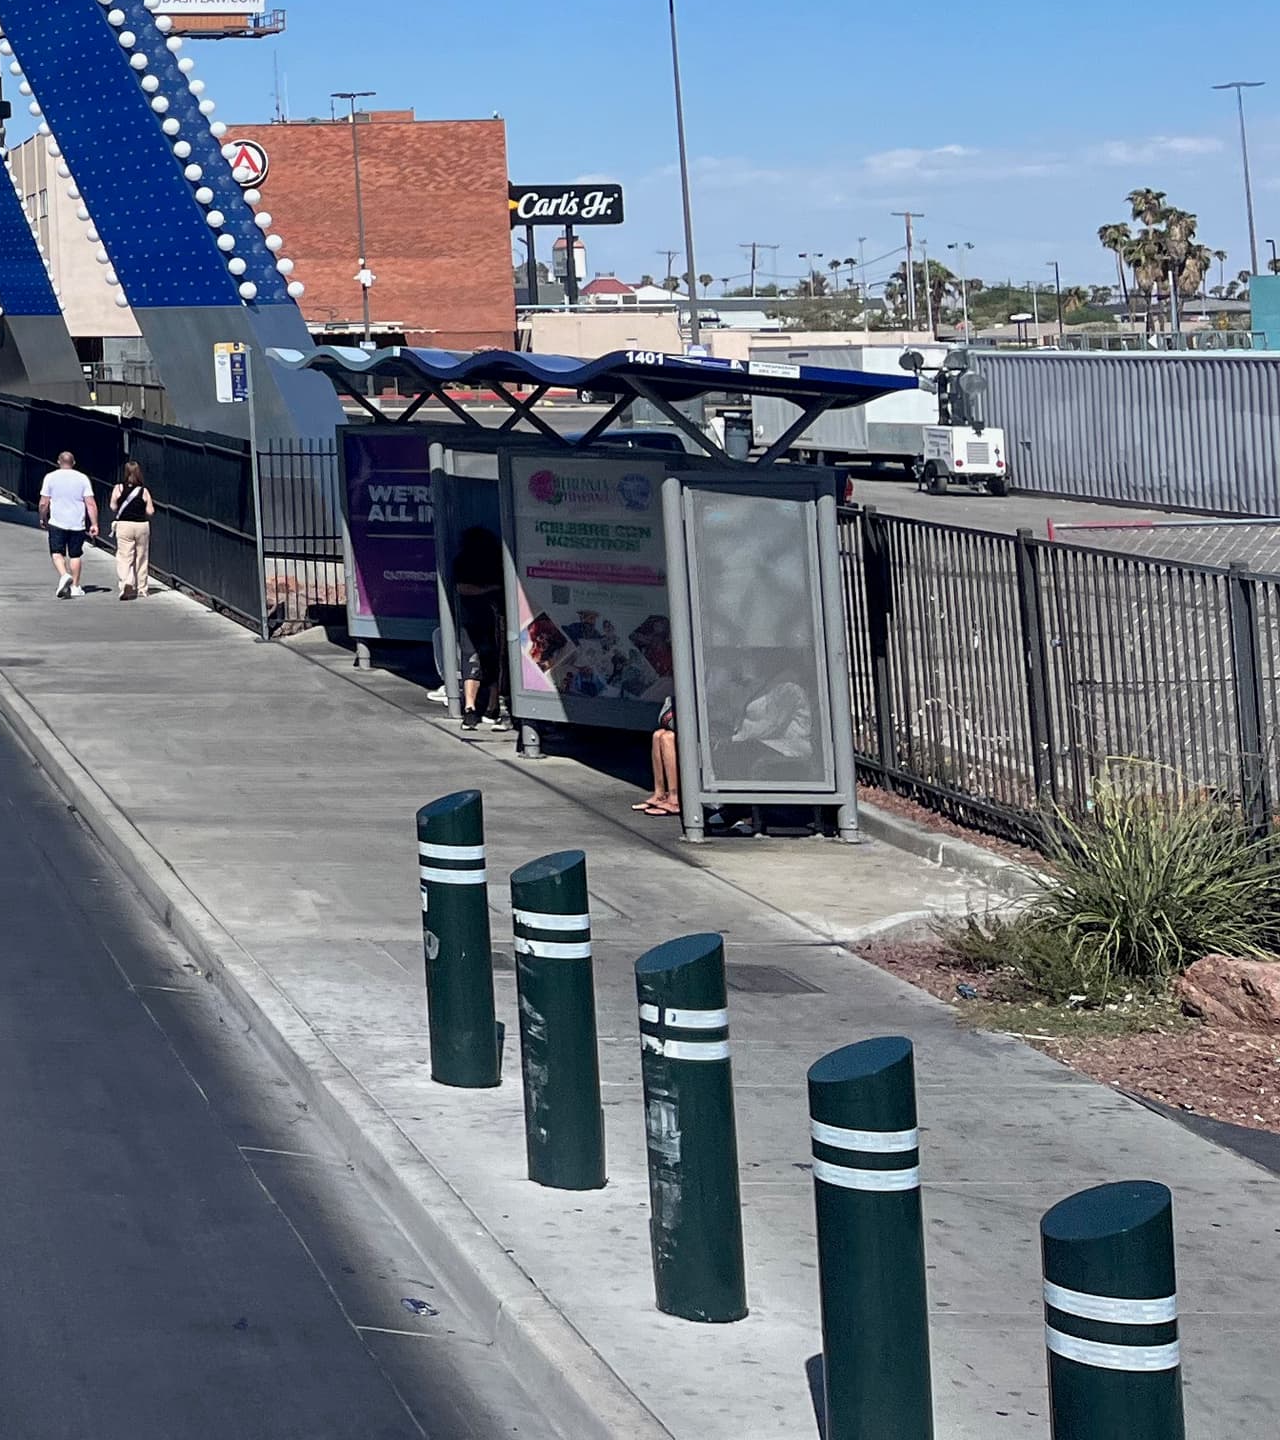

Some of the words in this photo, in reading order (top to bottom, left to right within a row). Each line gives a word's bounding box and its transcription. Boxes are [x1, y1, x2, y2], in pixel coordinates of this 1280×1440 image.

[518, 191, 579, 218] Carl's
[581, 191, 614, 218] Jr.
[625, 351, 664, 365] 1401
[368, 484, 432, 504] WE'R
[368, 504, 414, 523] ALL
